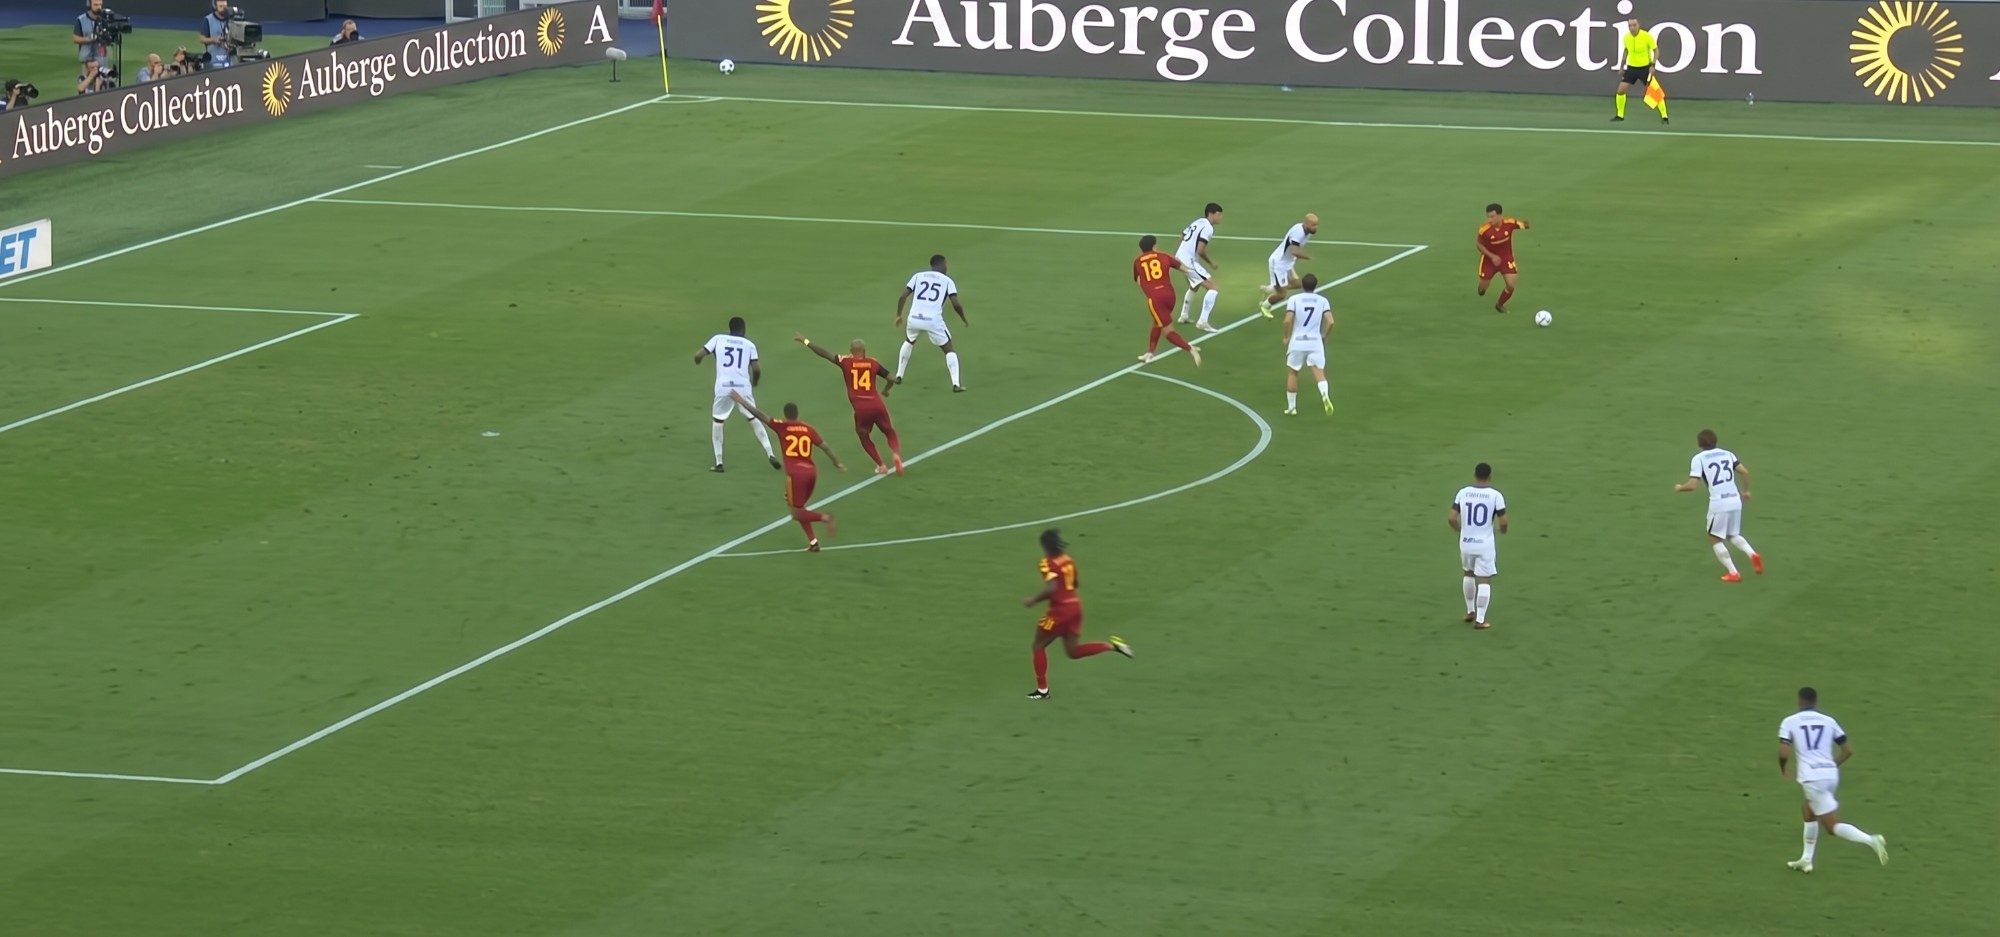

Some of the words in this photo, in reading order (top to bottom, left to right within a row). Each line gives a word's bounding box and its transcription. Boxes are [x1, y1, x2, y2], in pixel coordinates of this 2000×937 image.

[584, 4, 613, 45] A
[891, 0, 1256, 81] Auberge
[1284, 0, 1763, 76] Collection
[297, 50, 396, 100] Auberge
[402, 16, 527, 77] Collection
[12, 107, 115, 159] Auberge
[120, 77, 244, 135] Collection
[1141, 260, 1163, 282] 18
[916, 281, 942, 302] 25
[1304, 306, 1315, 327] 7
[722, 346, 744, 369] 31
[850, 369, 872, 391] 14
[785, 434, 812, 458] 20
[1707, 459, 1734, 487] 23
[1465, 501, 1489, 527] 10
[1799, 724, 1826, 751] 17
